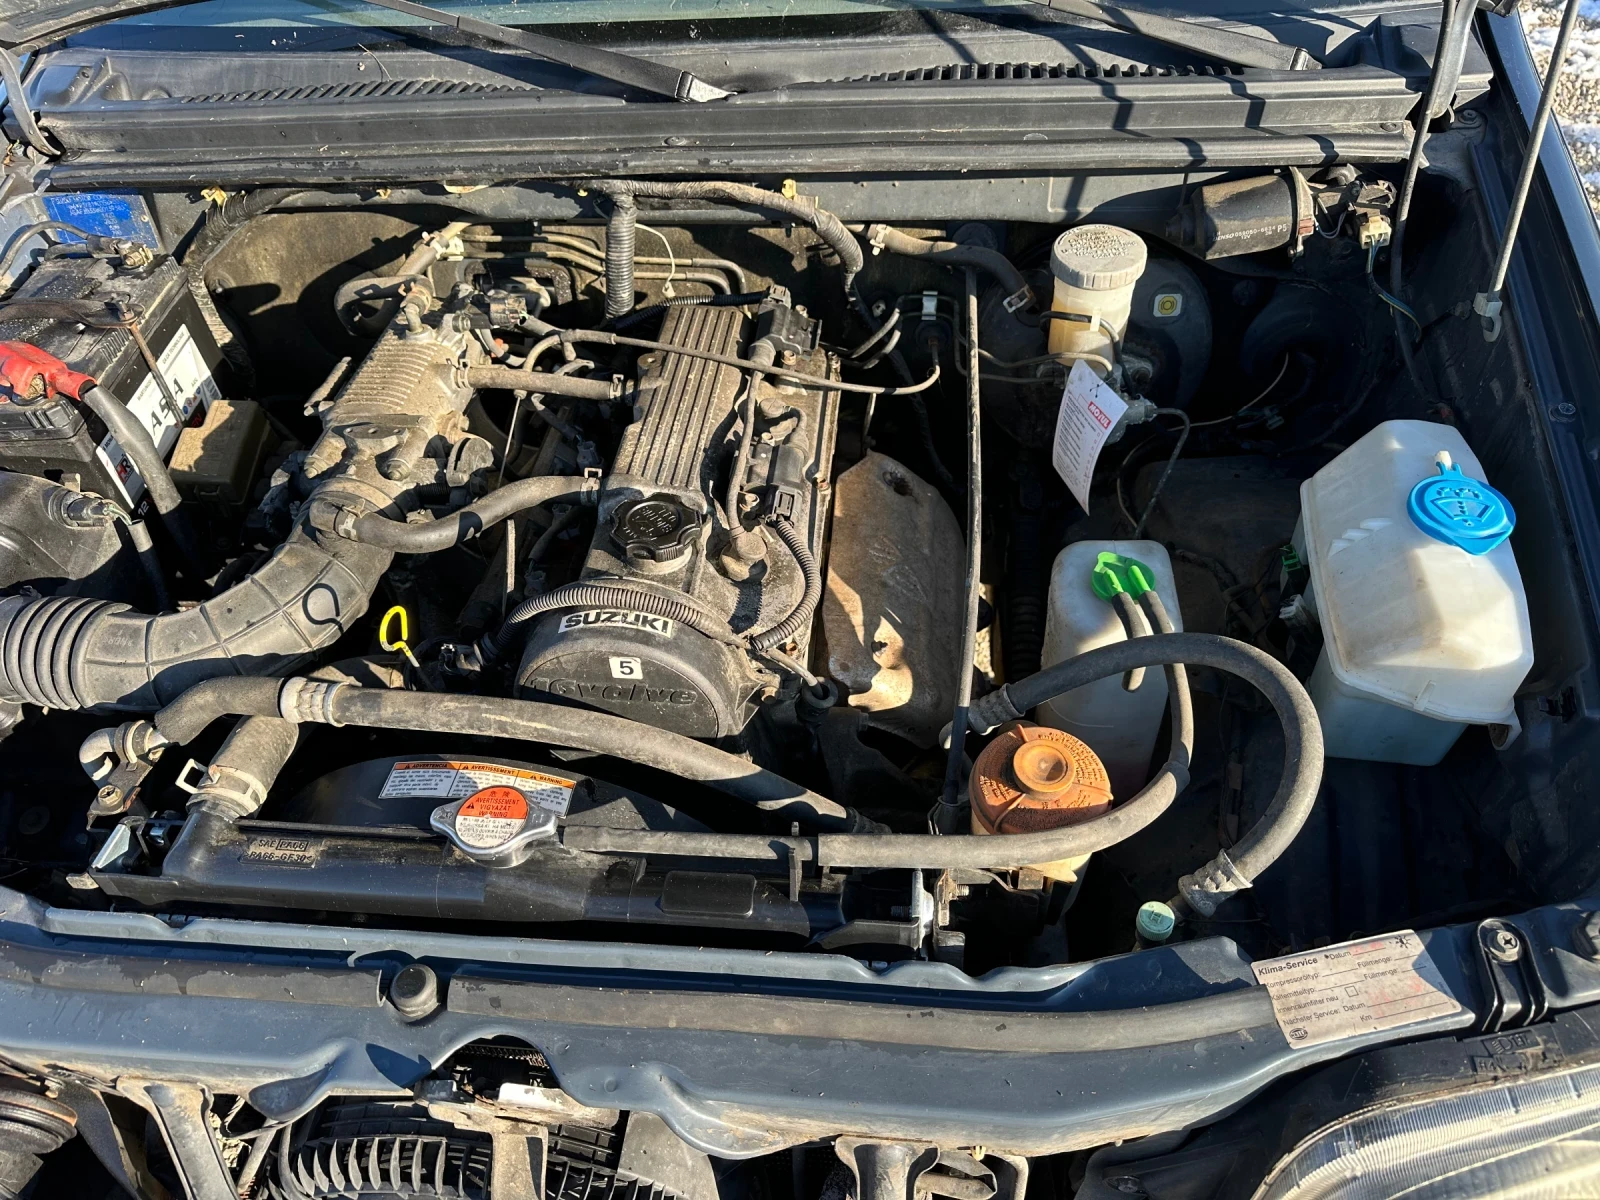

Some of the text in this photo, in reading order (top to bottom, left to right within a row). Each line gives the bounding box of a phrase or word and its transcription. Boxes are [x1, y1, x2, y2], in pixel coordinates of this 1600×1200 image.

[1277, 223, 1288, 233] P5
[1089, 402, 1111, 429] MOTUL
[564, 611, 670, 632] SUZUKI
[619, 660, 634, 676] 5
[470, 765, 515, 775] AVERTISSEMENT
[539, 776, 563, 785] WARNING
[478, 810, 508, 818] WARNING
[258, 840, 276, 848] SAE
[1258, 950, 1352, 976] Klima-Service Datum
[1357, 955, 1393, 968] Füllmenge:
[1363, 968, 1399, 981] Füllmenge:
[1276, 995, 1339, 1014] Innenraumfilter neu
[1313, 1008, 1341, 1021] Service:
[1343, 1002, 1366, 1012] Datum
[1359, 1014, 1373, 1022] Km
